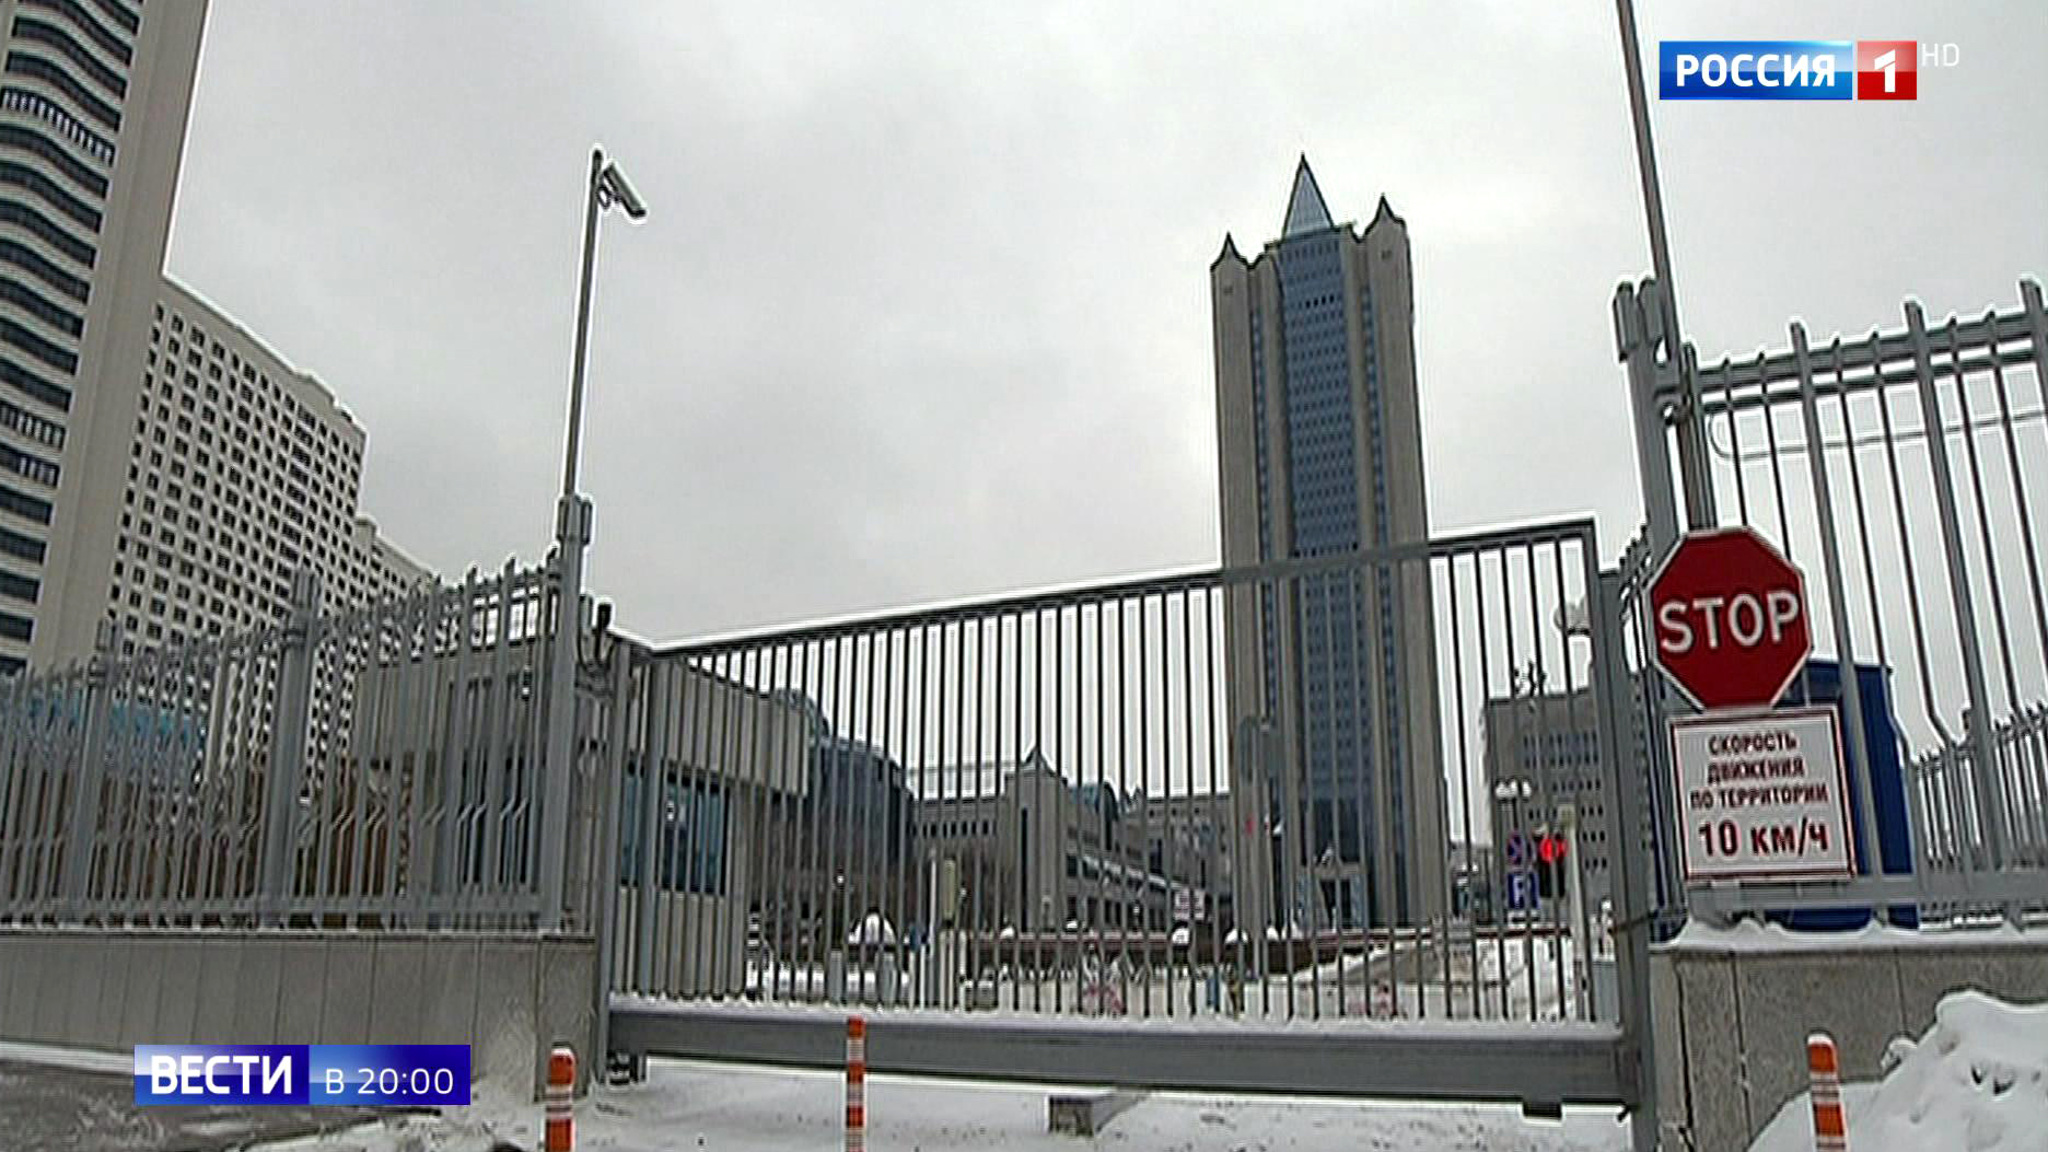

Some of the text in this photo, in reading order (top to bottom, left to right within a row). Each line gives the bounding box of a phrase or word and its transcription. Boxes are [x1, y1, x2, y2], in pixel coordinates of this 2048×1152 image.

[1660, 590, 1798, 653] STOP
[1709, 730, 1797, 755] СКОРОСТЬ
[1708, 756, 1805, 786] ДВИЖЕНИЯ
[1690, 783, 1829, 810] ПО ТЕРРИТОРИИ
[1699, 819, 1738, 857] 10
